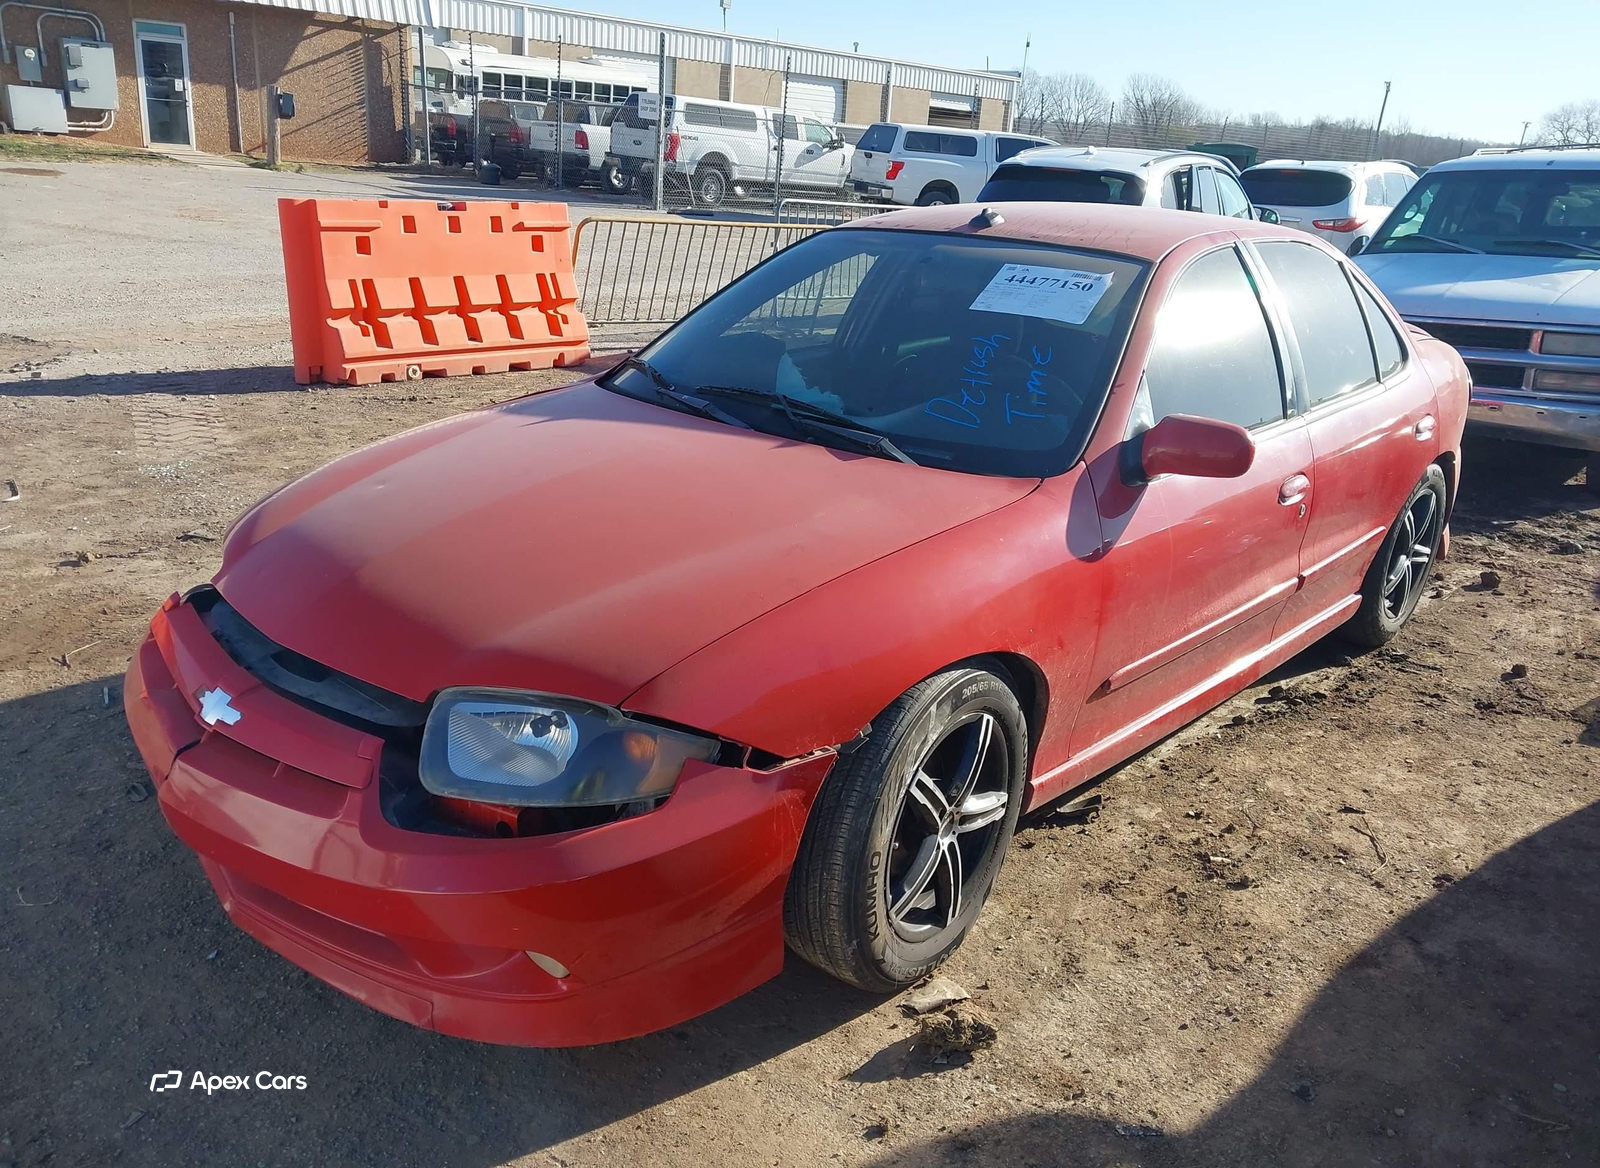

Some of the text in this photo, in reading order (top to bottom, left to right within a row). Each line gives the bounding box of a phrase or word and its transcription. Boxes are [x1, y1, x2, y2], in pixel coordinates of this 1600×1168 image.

[1004, 274, 1094, 292] 44477150
[961, 681, 989, 700] 205/65
[865, 851, 882, 943] KUMHO
